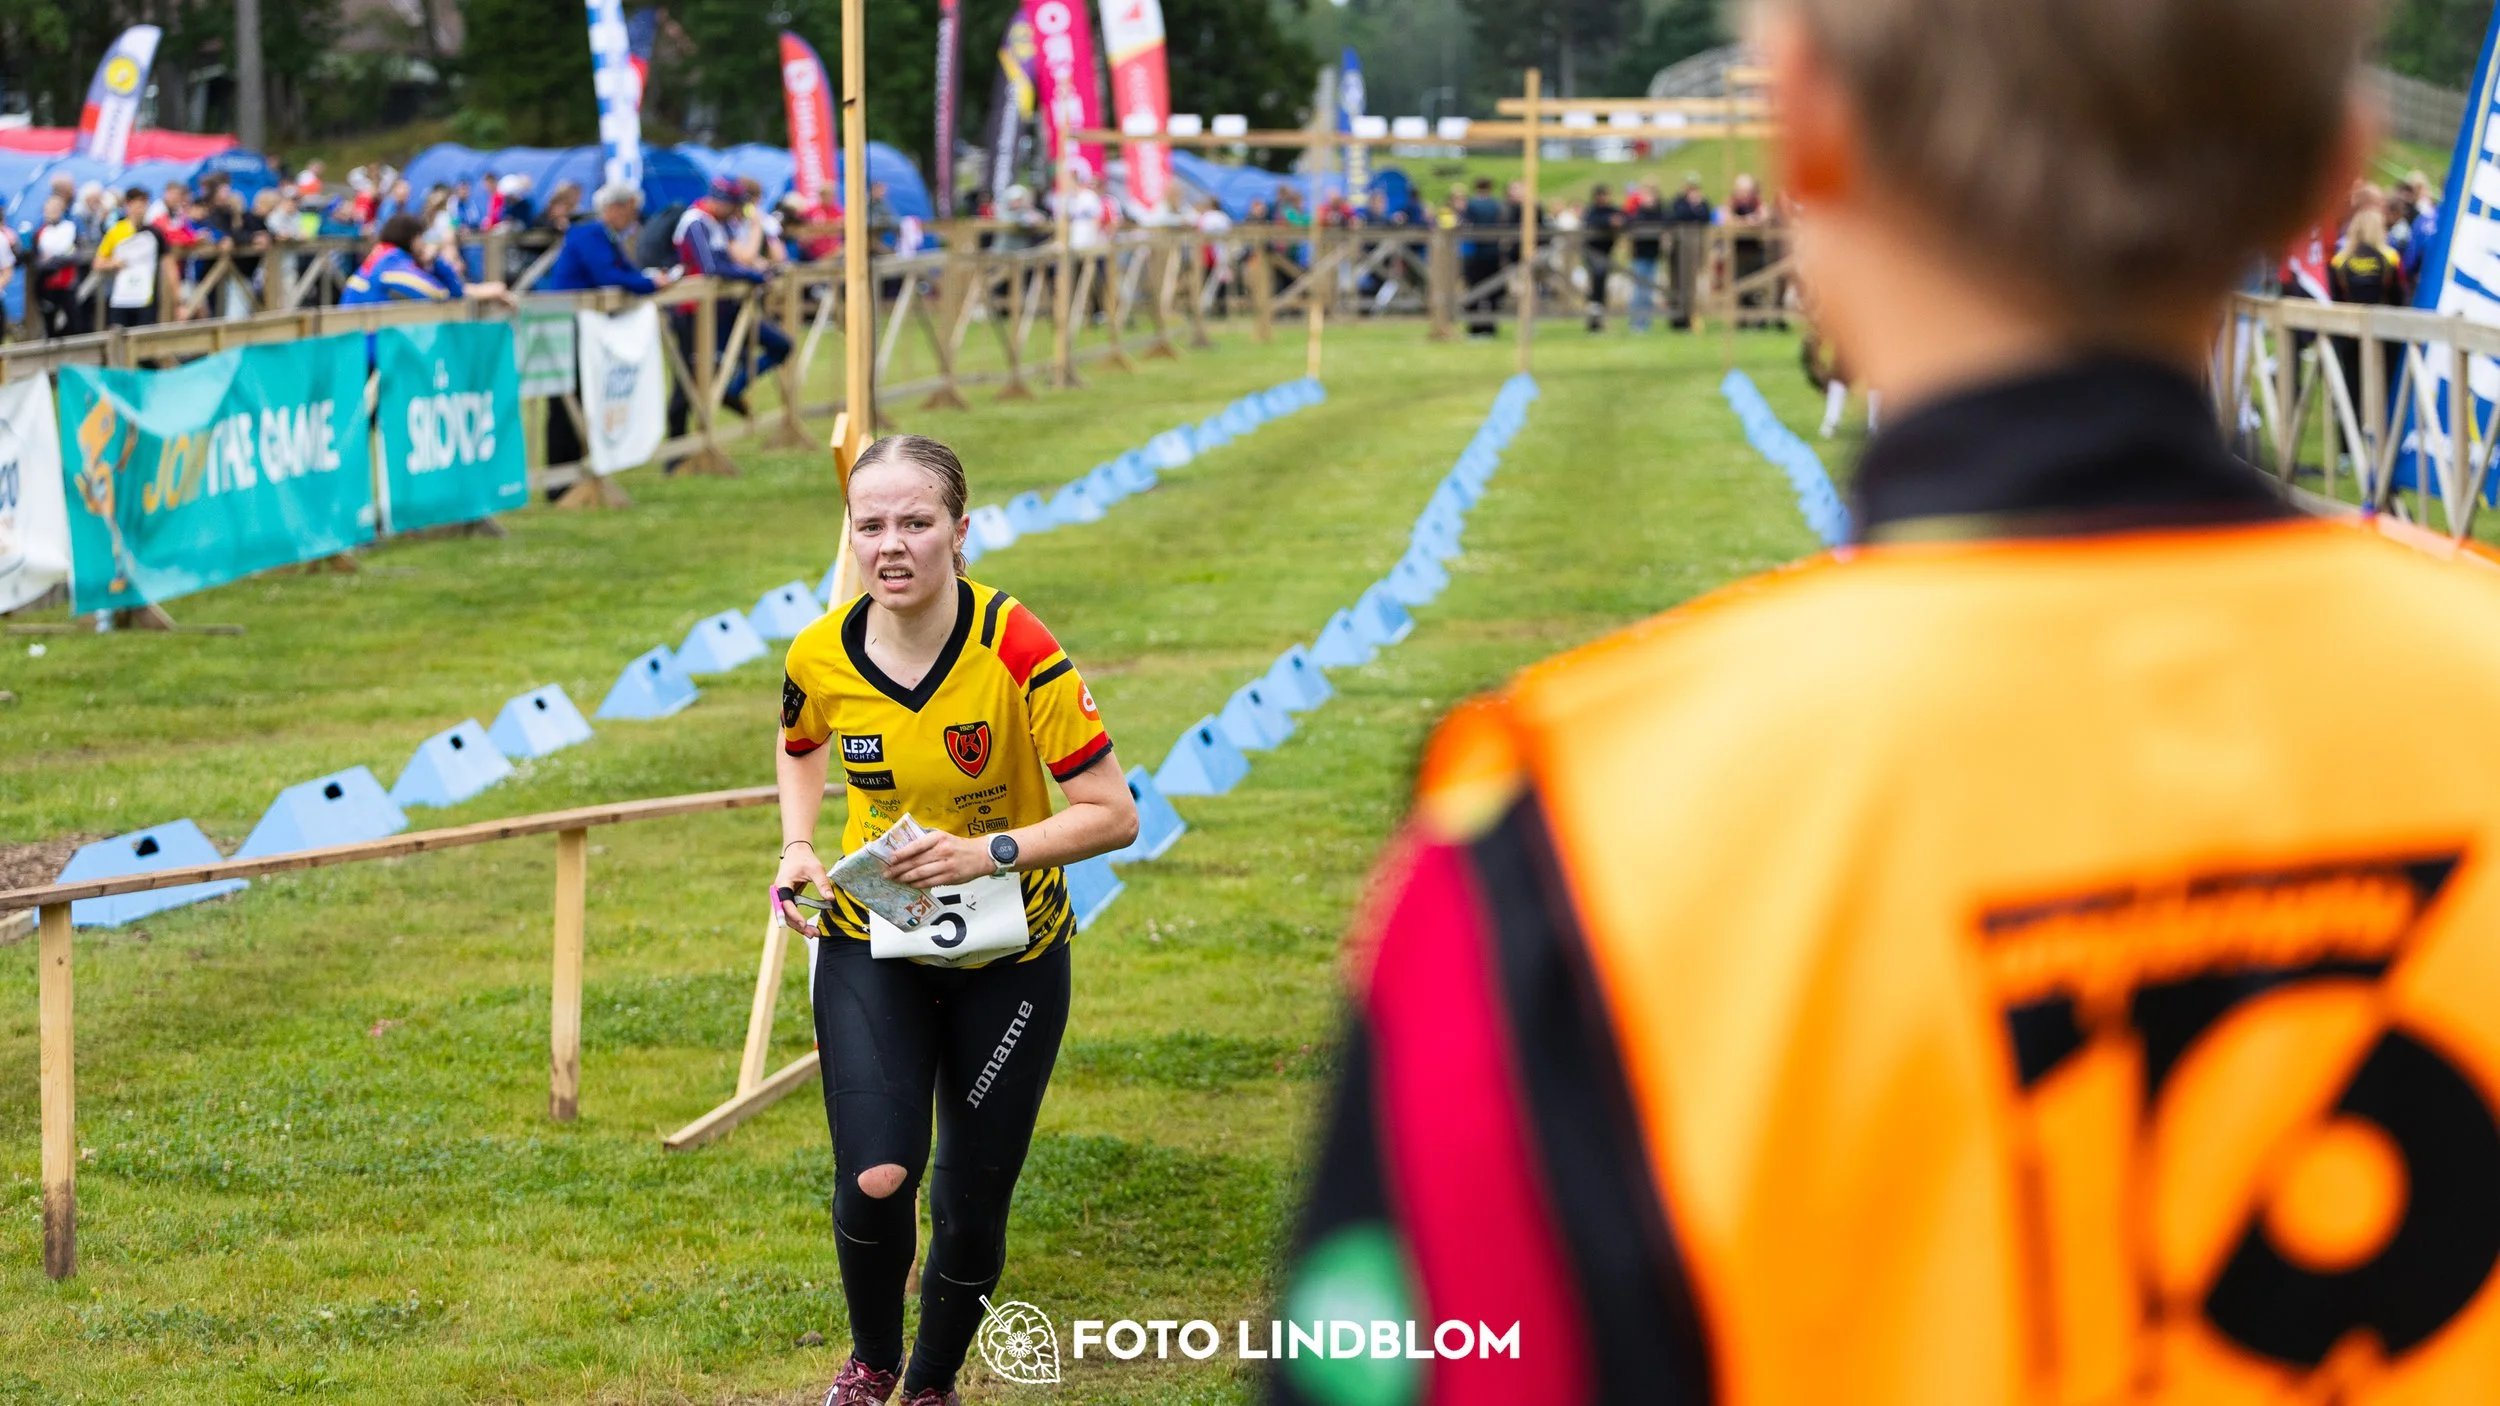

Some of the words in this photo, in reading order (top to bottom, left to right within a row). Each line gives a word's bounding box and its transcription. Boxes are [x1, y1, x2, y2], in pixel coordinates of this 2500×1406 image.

[843, 738, 880, 754] LEDX
[953, 783, 1007, 805] PYYNIKIN
[930, 893, 967, 949] 5
[967, 1001, 1033, 1109] noname
